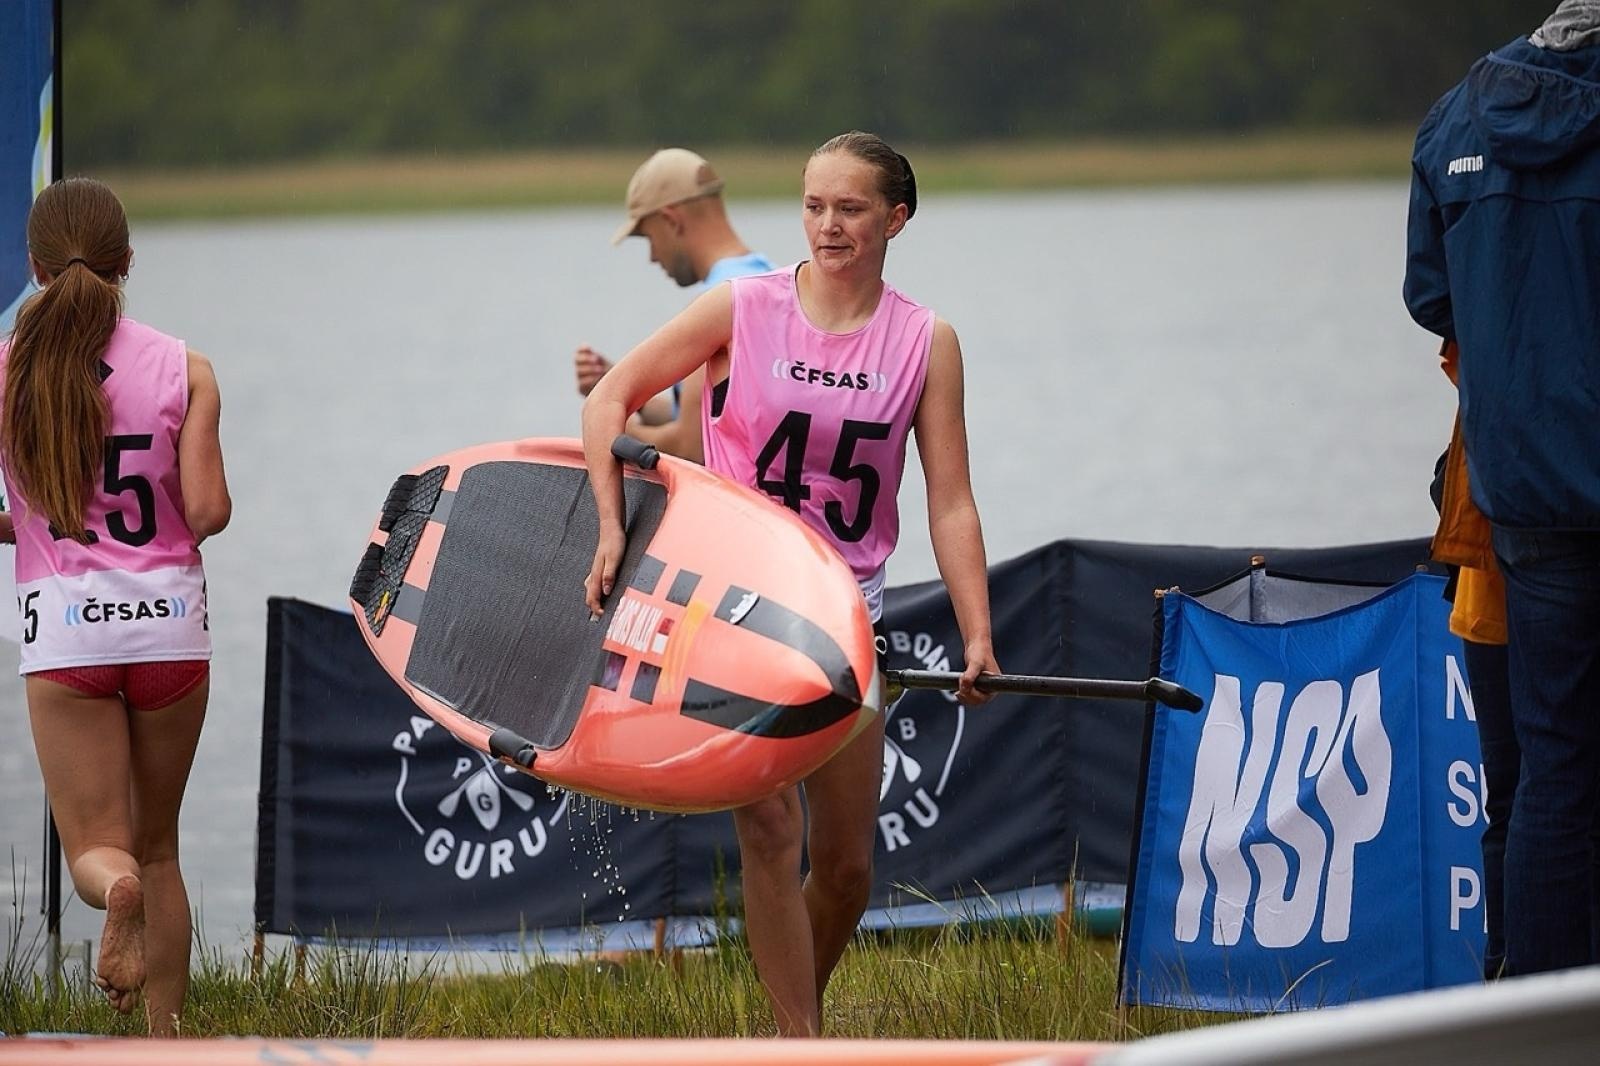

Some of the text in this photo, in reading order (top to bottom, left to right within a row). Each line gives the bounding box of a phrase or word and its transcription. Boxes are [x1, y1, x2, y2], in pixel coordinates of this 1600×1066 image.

[1447, 154, 1484, 176] PUMA
[790, 360, 870, 391] ČFSAS
[48, 433, 157, 548] 5
[755, 410, 892, 543] 45
[17, 590, 41, 644] 5
[82, 597, 171, 624] ČFSAS
[878, 787, 940, 853] RU
[1174, 667, 1393, 949] NSP
[424, 816, 548, 880] GURU
